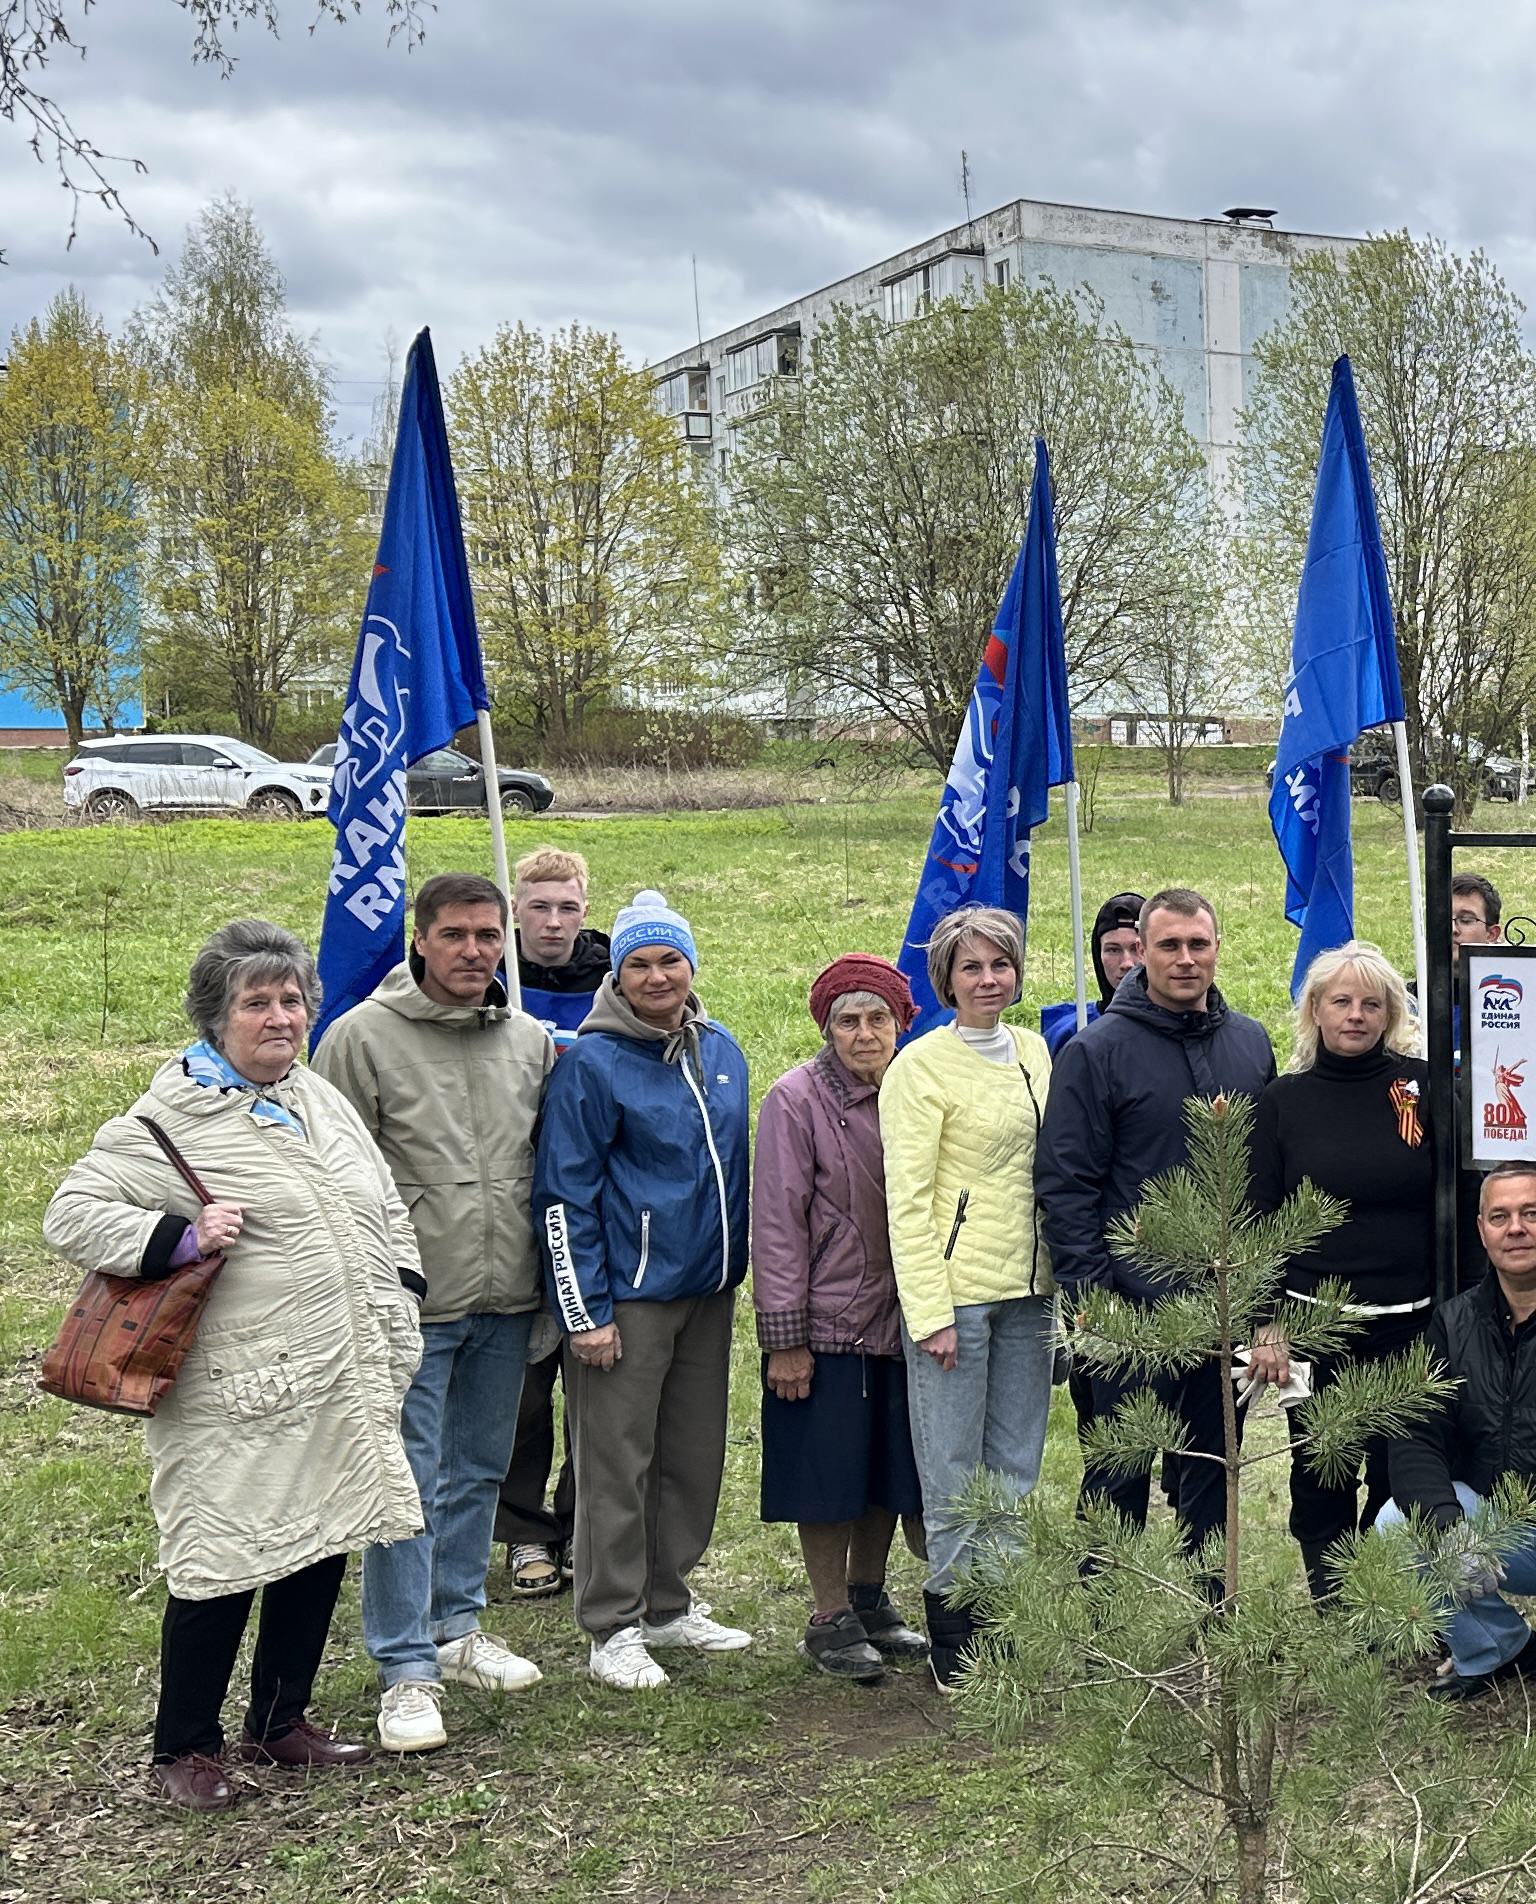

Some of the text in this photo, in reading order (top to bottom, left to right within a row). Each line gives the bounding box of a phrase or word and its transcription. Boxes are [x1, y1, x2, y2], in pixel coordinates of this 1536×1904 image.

[1481, 1020, 1521, 1030] РОССИЯ
[1483, 1102, 1508, 1125] 80
[1483, 1128, 1528, 1142] ПОБЕДА!
[550, 1209, 568, 1272] РОССИЯ
